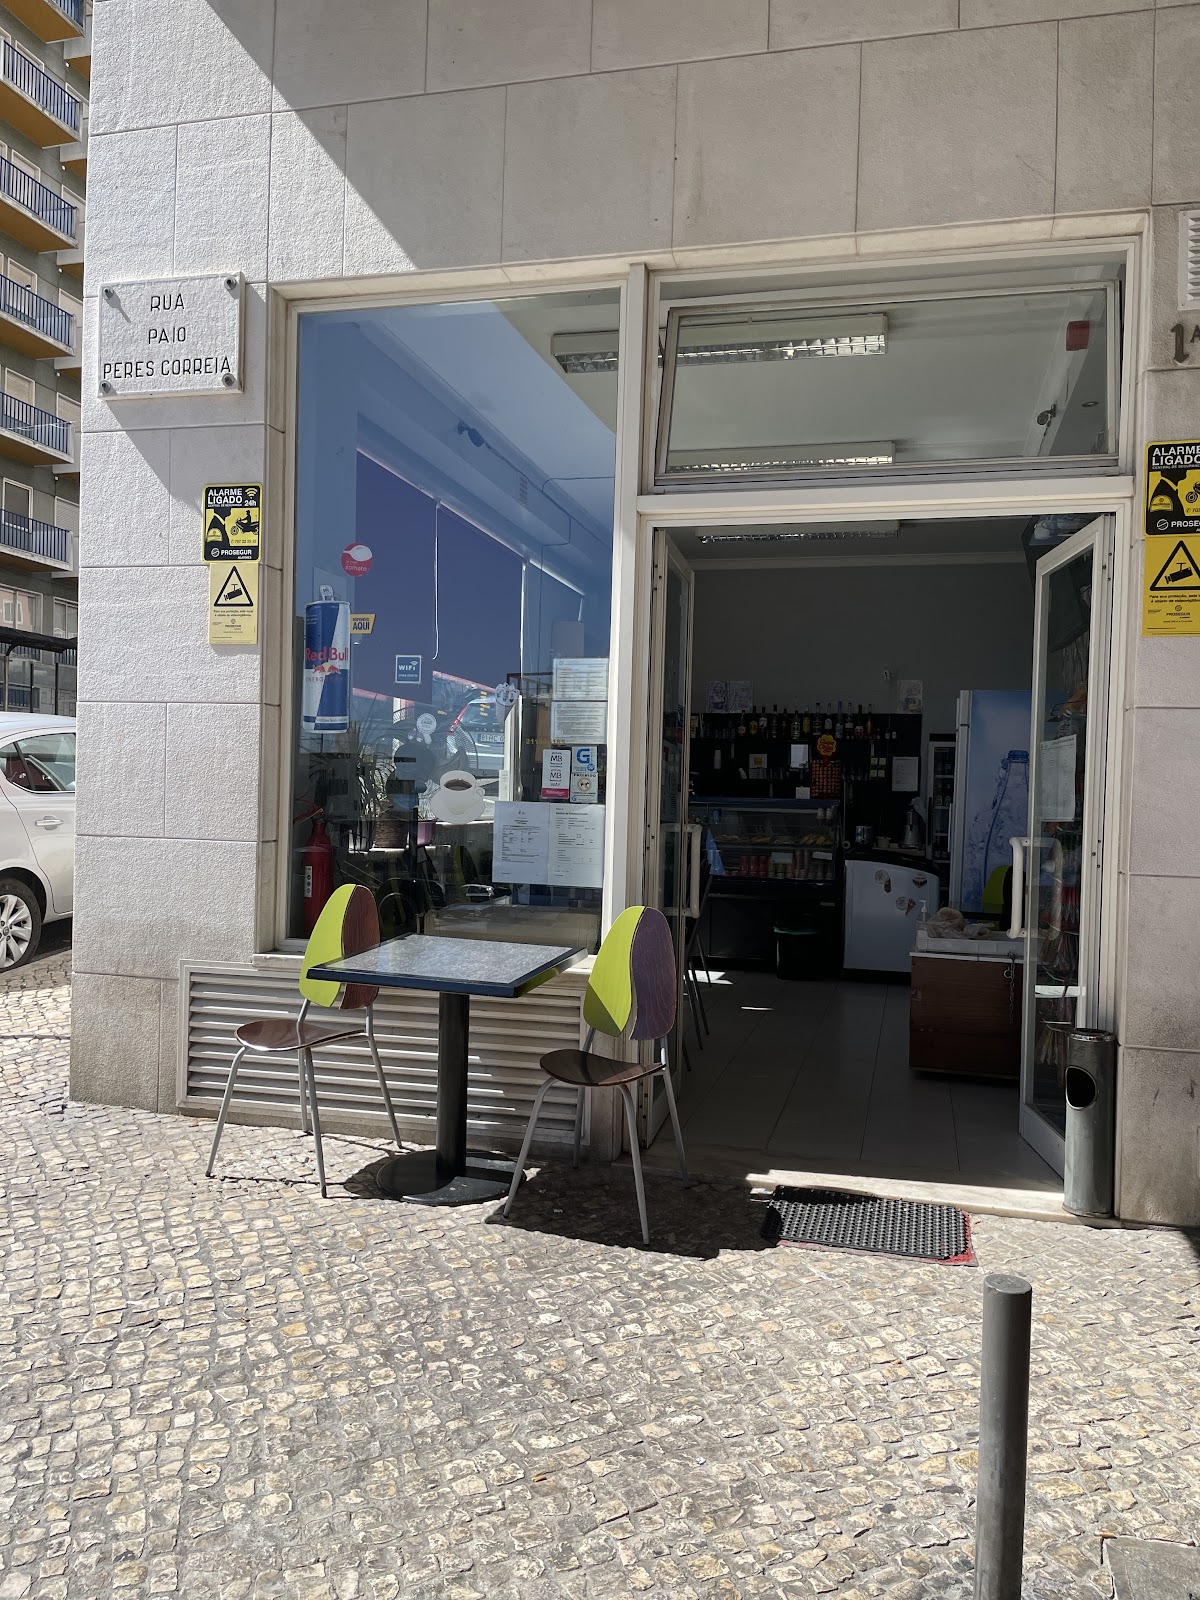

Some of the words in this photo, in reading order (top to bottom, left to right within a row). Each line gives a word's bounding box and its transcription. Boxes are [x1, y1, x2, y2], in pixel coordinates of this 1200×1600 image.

[150, 293, 185, 312] RUA
[148, 327, 186, 344] PAIO
[103, 360, 155, 379] PERES
[161, 356, 231, 376] CORREIA
[1152, 445, 1200, 456] ALARME
[208, 496, 242, 504] LIGADO
[353, 622, 369, 630] AQUI
[305, 646, 327, 661] Red
[330, 647, 348, 661] Bull
